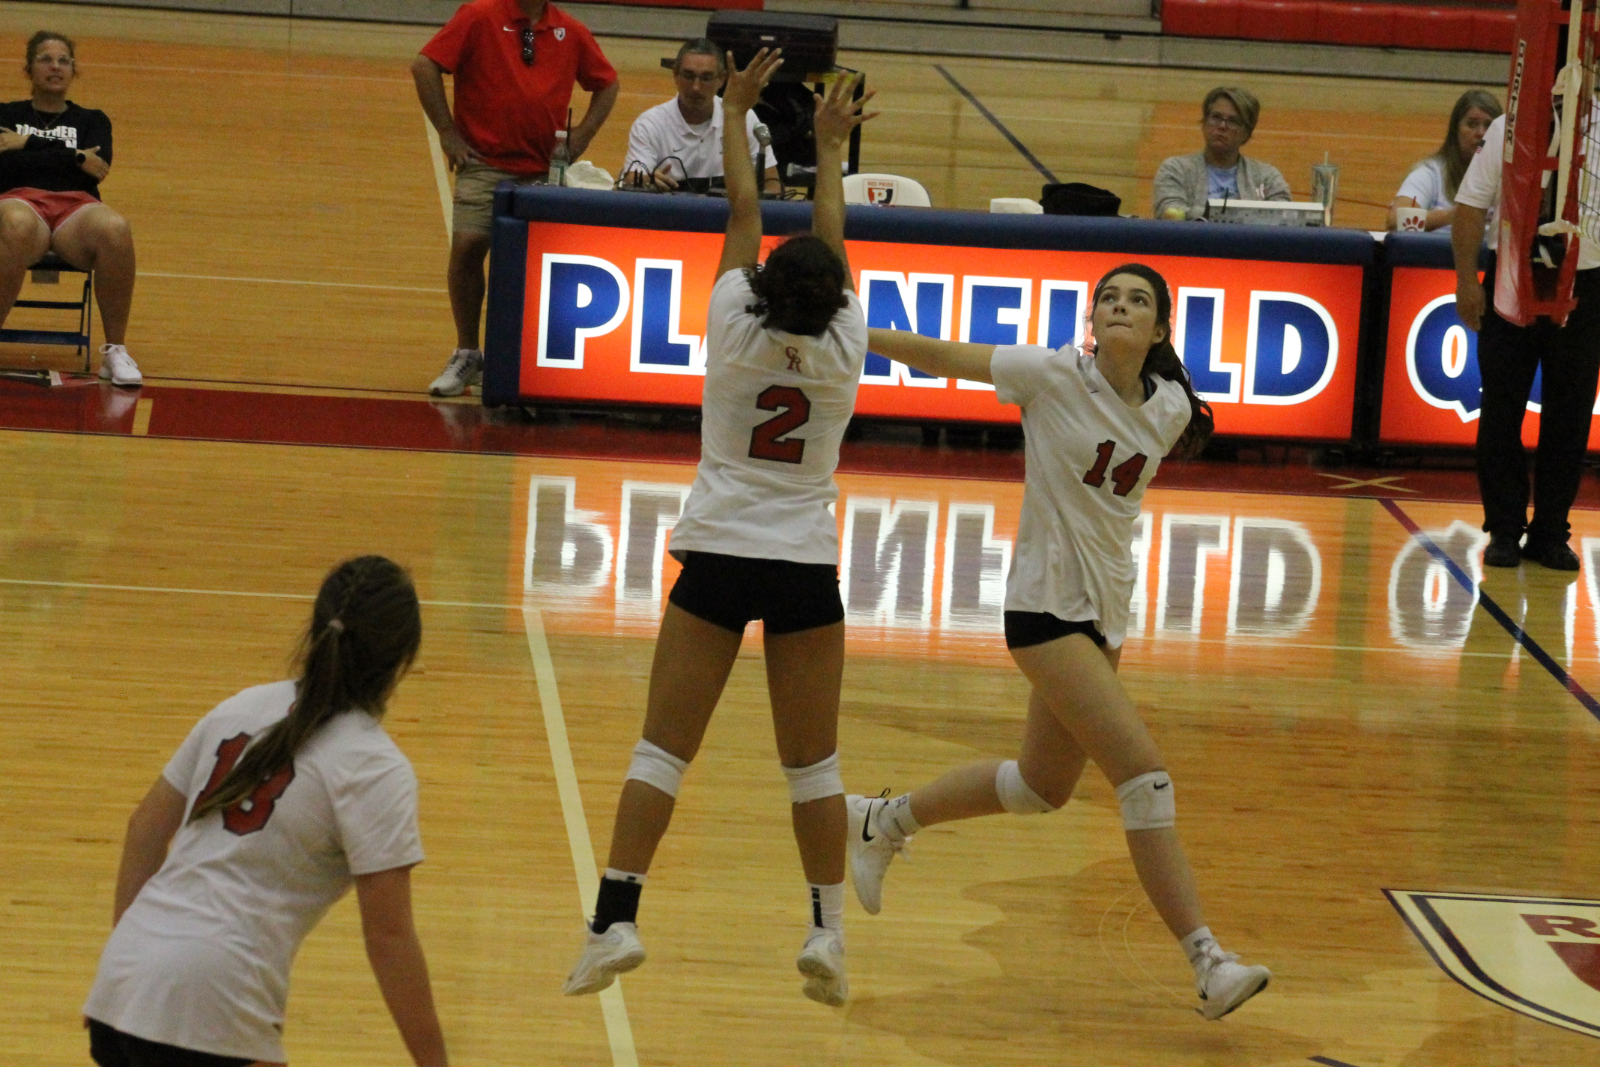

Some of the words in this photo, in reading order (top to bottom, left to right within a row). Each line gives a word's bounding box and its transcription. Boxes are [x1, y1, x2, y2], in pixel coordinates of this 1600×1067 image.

[537, 253, 1339, 405] PLNFILD
[748, 384, 811, 464] 2
[1082, 439, 1148, 497] 14
